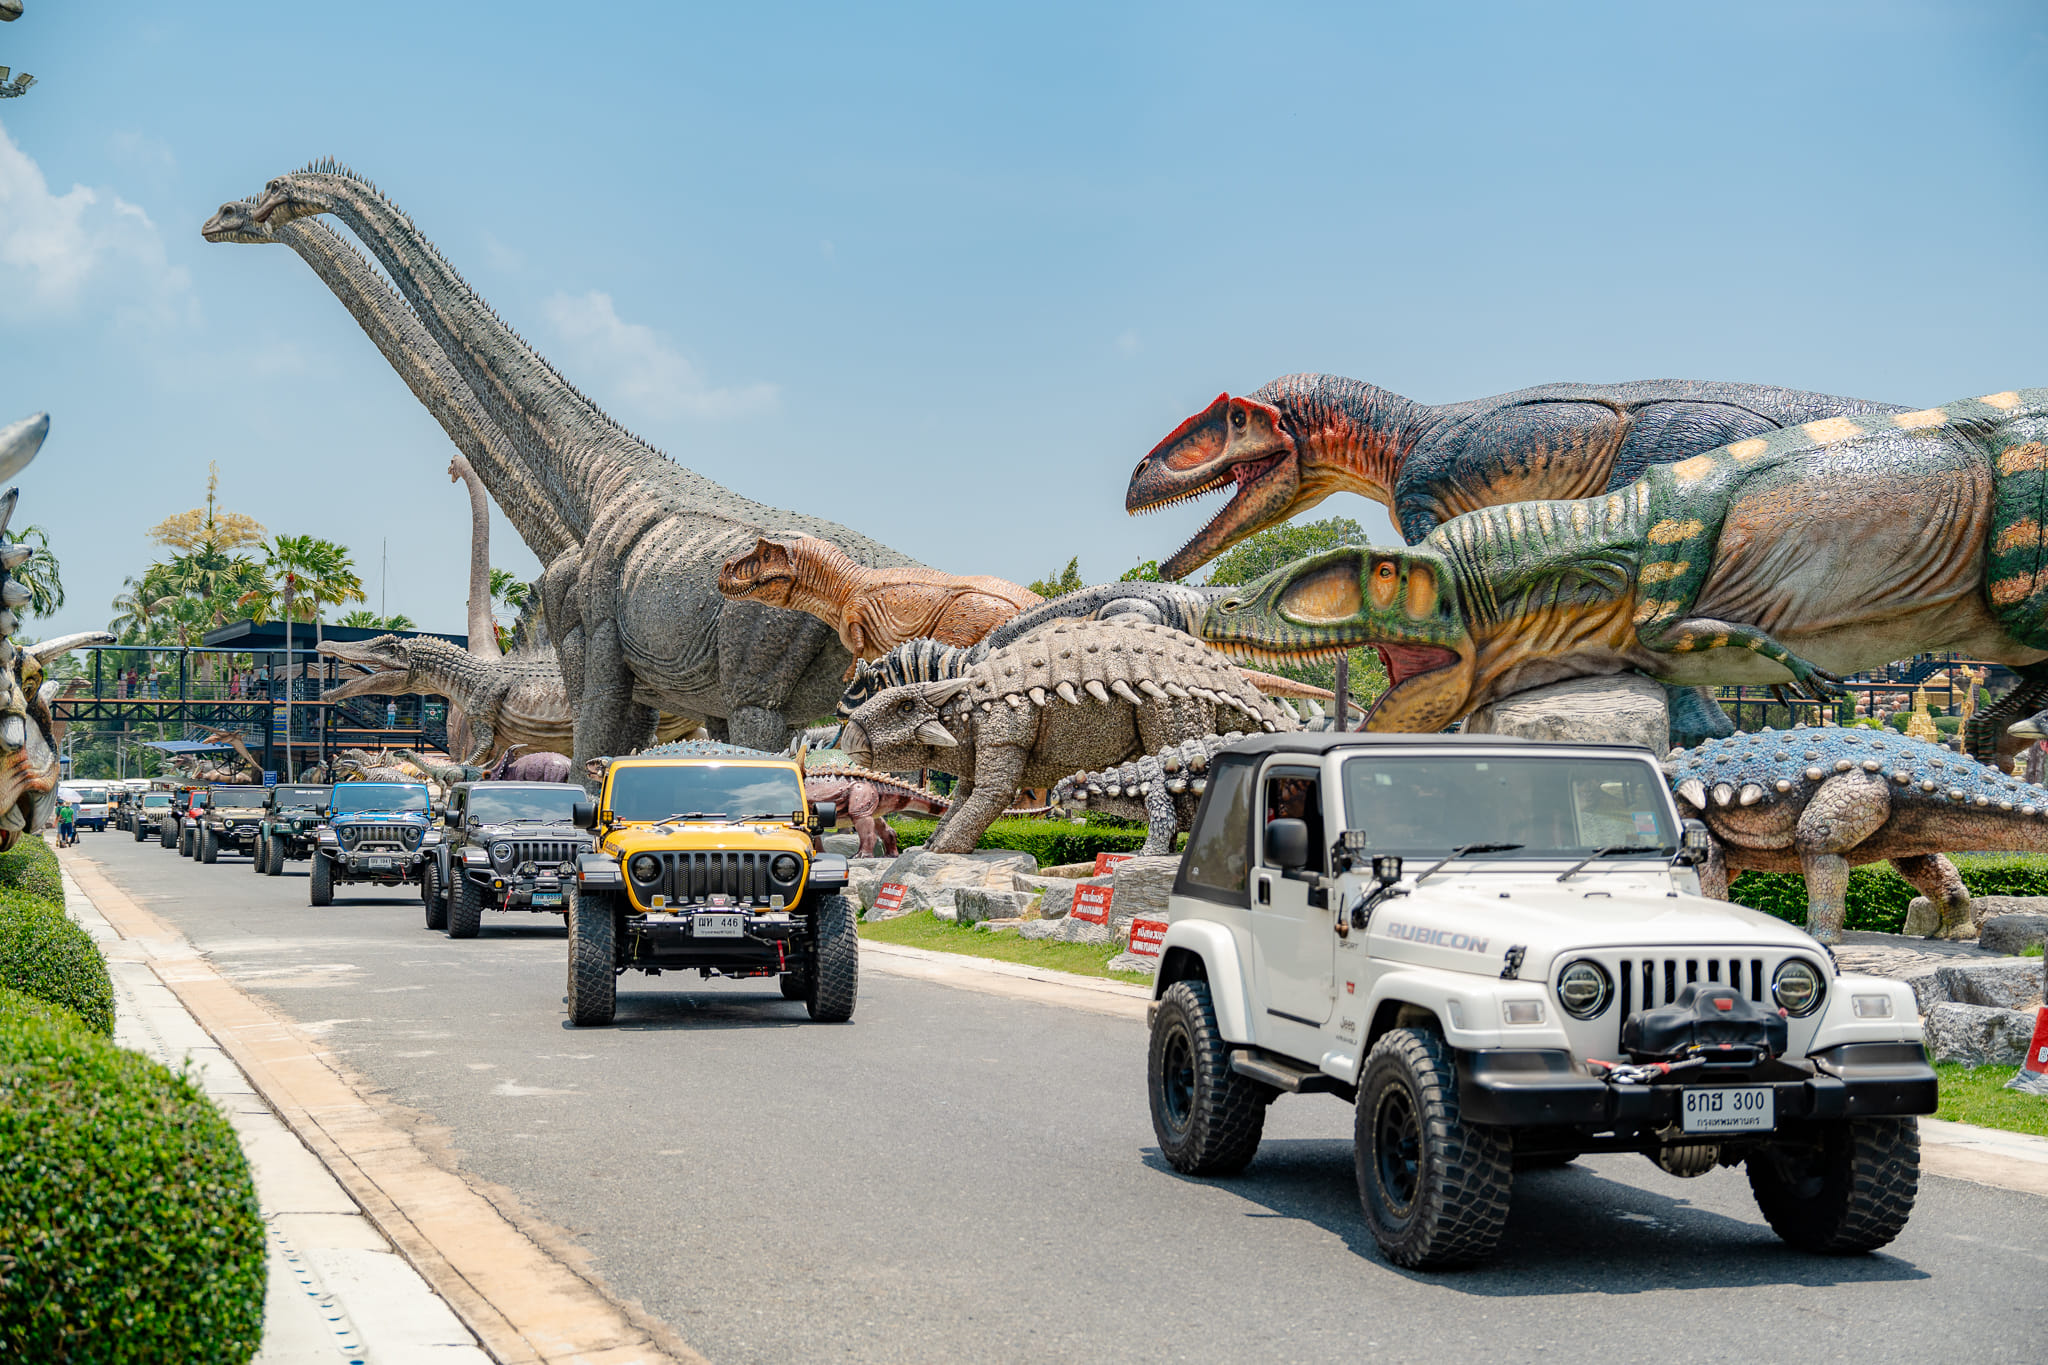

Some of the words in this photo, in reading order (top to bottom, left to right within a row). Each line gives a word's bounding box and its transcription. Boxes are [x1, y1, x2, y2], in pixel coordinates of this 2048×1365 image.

[720, 917, 739, 928] 446
[1387, 922, 1490, 953] RUBICON
[1340, 1016, 1355, 1032] Jeep
[1687, 1092, 1723, 1112] 8กฮ
[1734, 1092, 1764, 1111] 300
[1697, 1116, 1760, 1130] กรุงเทพมหานคร
